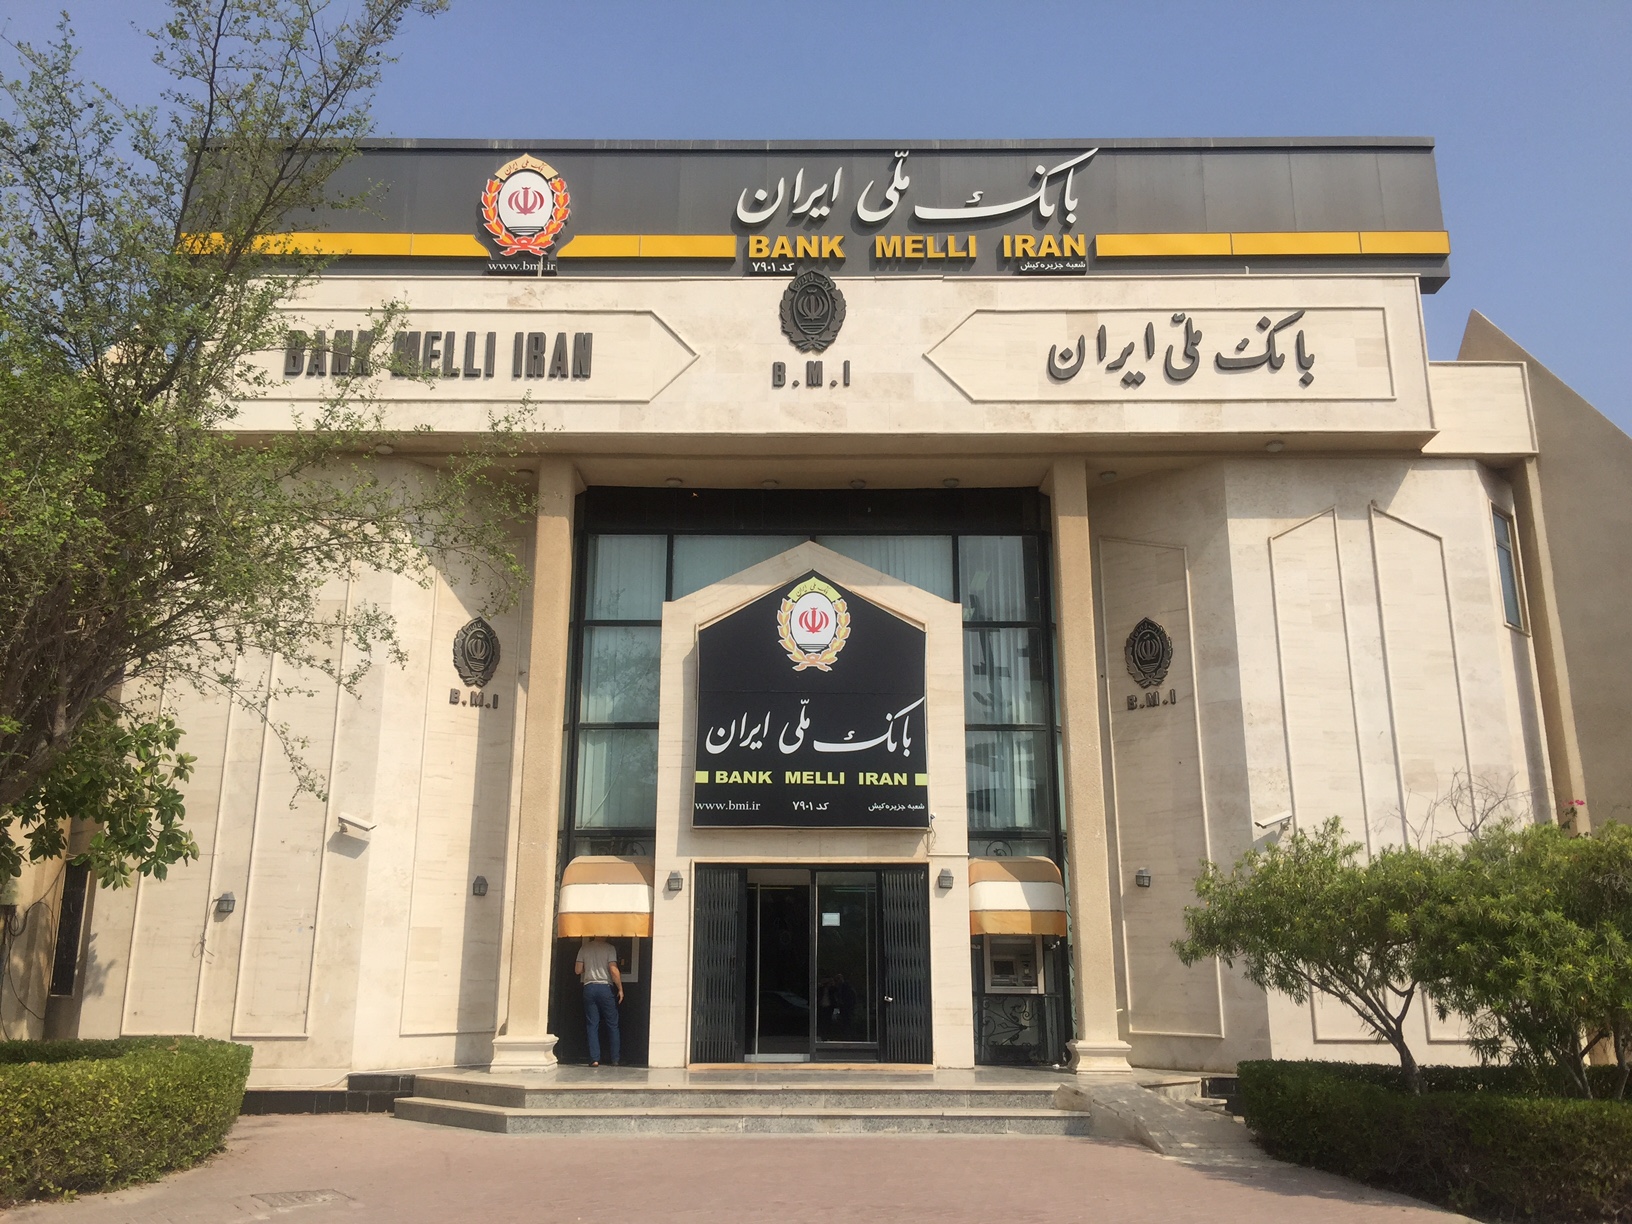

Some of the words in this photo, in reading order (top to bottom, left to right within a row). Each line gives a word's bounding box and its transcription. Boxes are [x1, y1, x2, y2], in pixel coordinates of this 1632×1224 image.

[736, 166, 843, 223] ایران
[748, 235, 846, 258] BANK
[875, 234, 977, 258] MELLI
[1003, 234, 1086, 258] IRAN
[488, 261, 556, 270] www.bm.ir
[752, 261, 776, 272] ۷۹۰۱
[779, 262, 795, 271] کد
[1065, 261, 1086, 270] شعبه
[285, 329, 375, 376] BANK
[392, 331, 497, 378] MELLI
[513, 331, 593, 378] IRAN
[1049, 321, 1155, 387] ایران
[705, 710, 771, 755] ایران
[715, 771, 773, 784] BANK
[785, 771, 845, 785] MELLI
[858, 772, 908, 786] IRAN
[695, 800, 761, 810] www.bmi.ir
[792, 801, 813, 811] ۷۹۰۱
[816, 802, 829, 810] کد
[907, 803, 925, 811] شعبه
